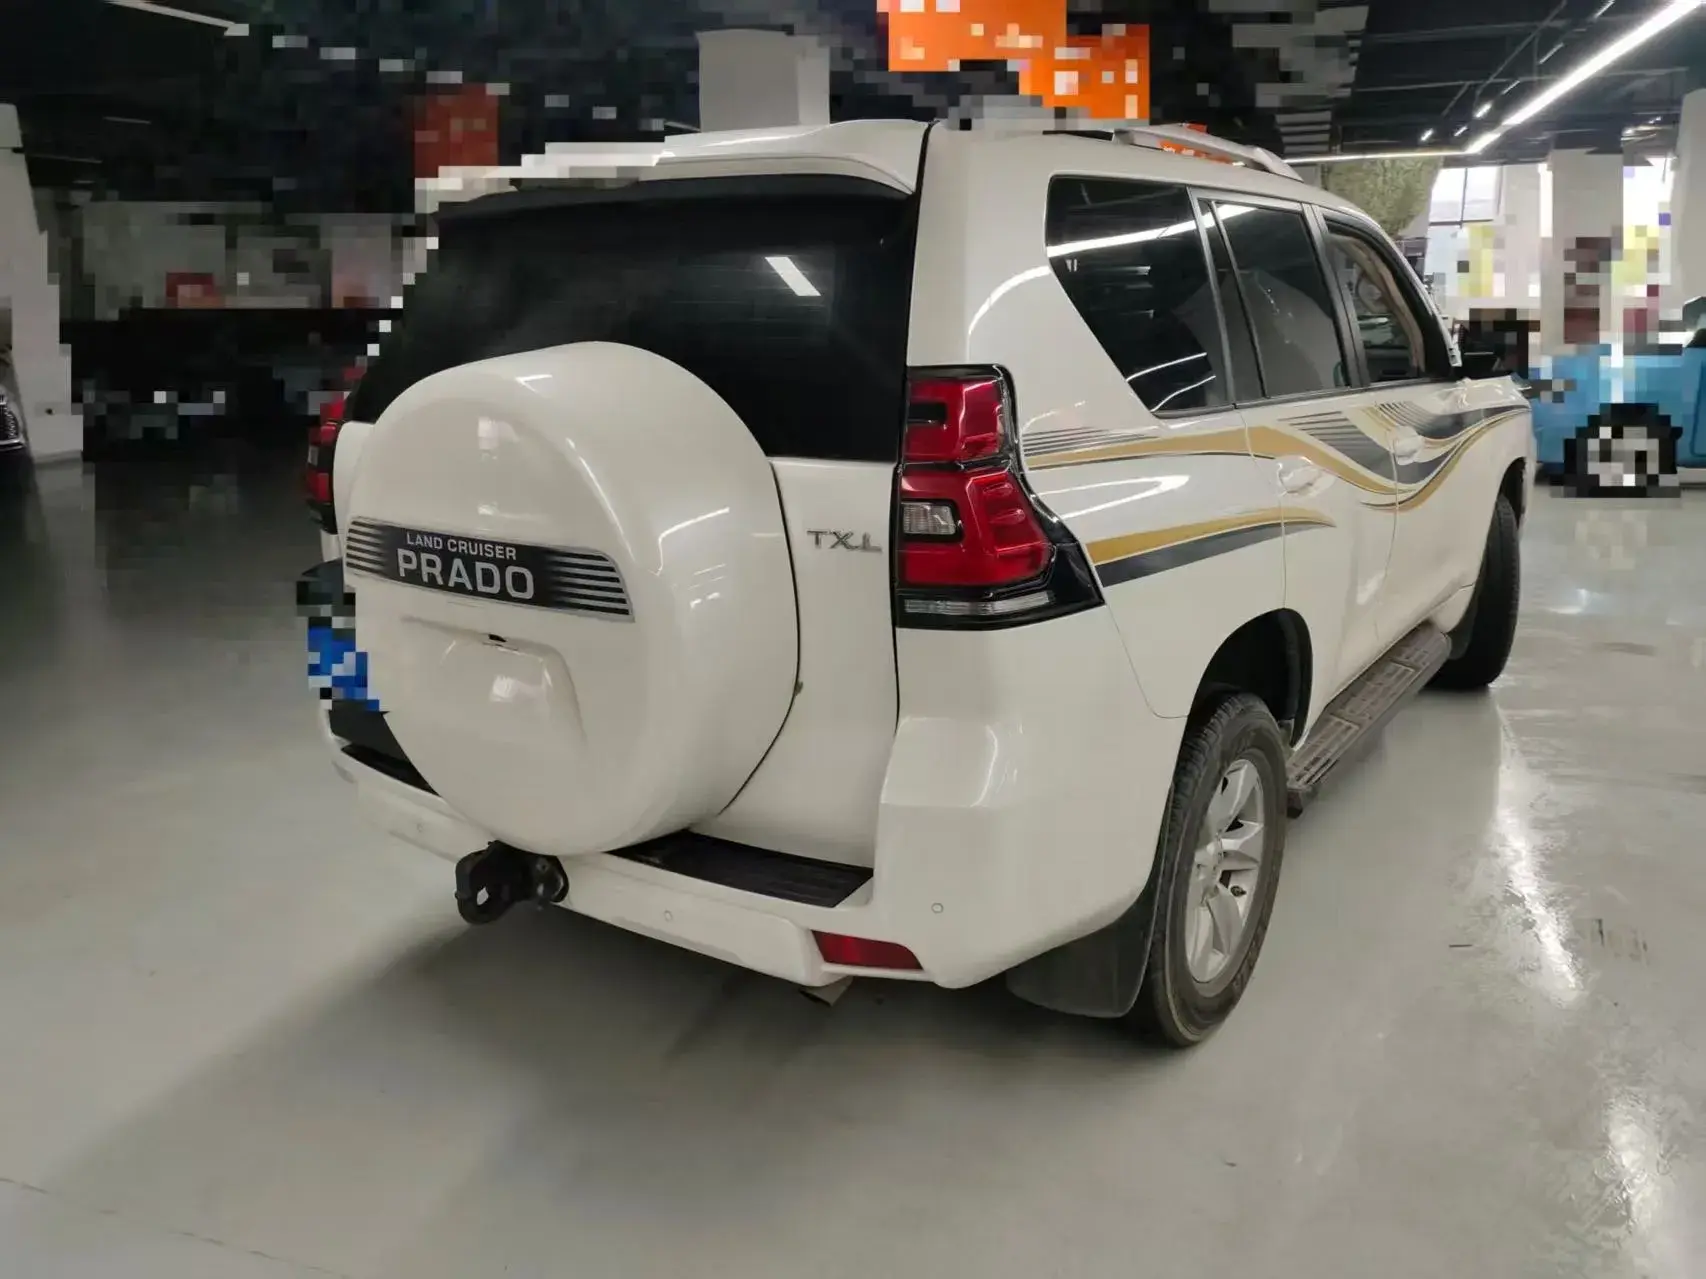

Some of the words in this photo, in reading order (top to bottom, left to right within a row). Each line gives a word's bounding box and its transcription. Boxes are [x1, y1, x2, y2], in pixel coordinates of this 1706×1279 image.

[406, 531, 443, 550] LAND
[447, 538, 517, 561] CRUISER
[397, 548, 535, 600] PRADO
